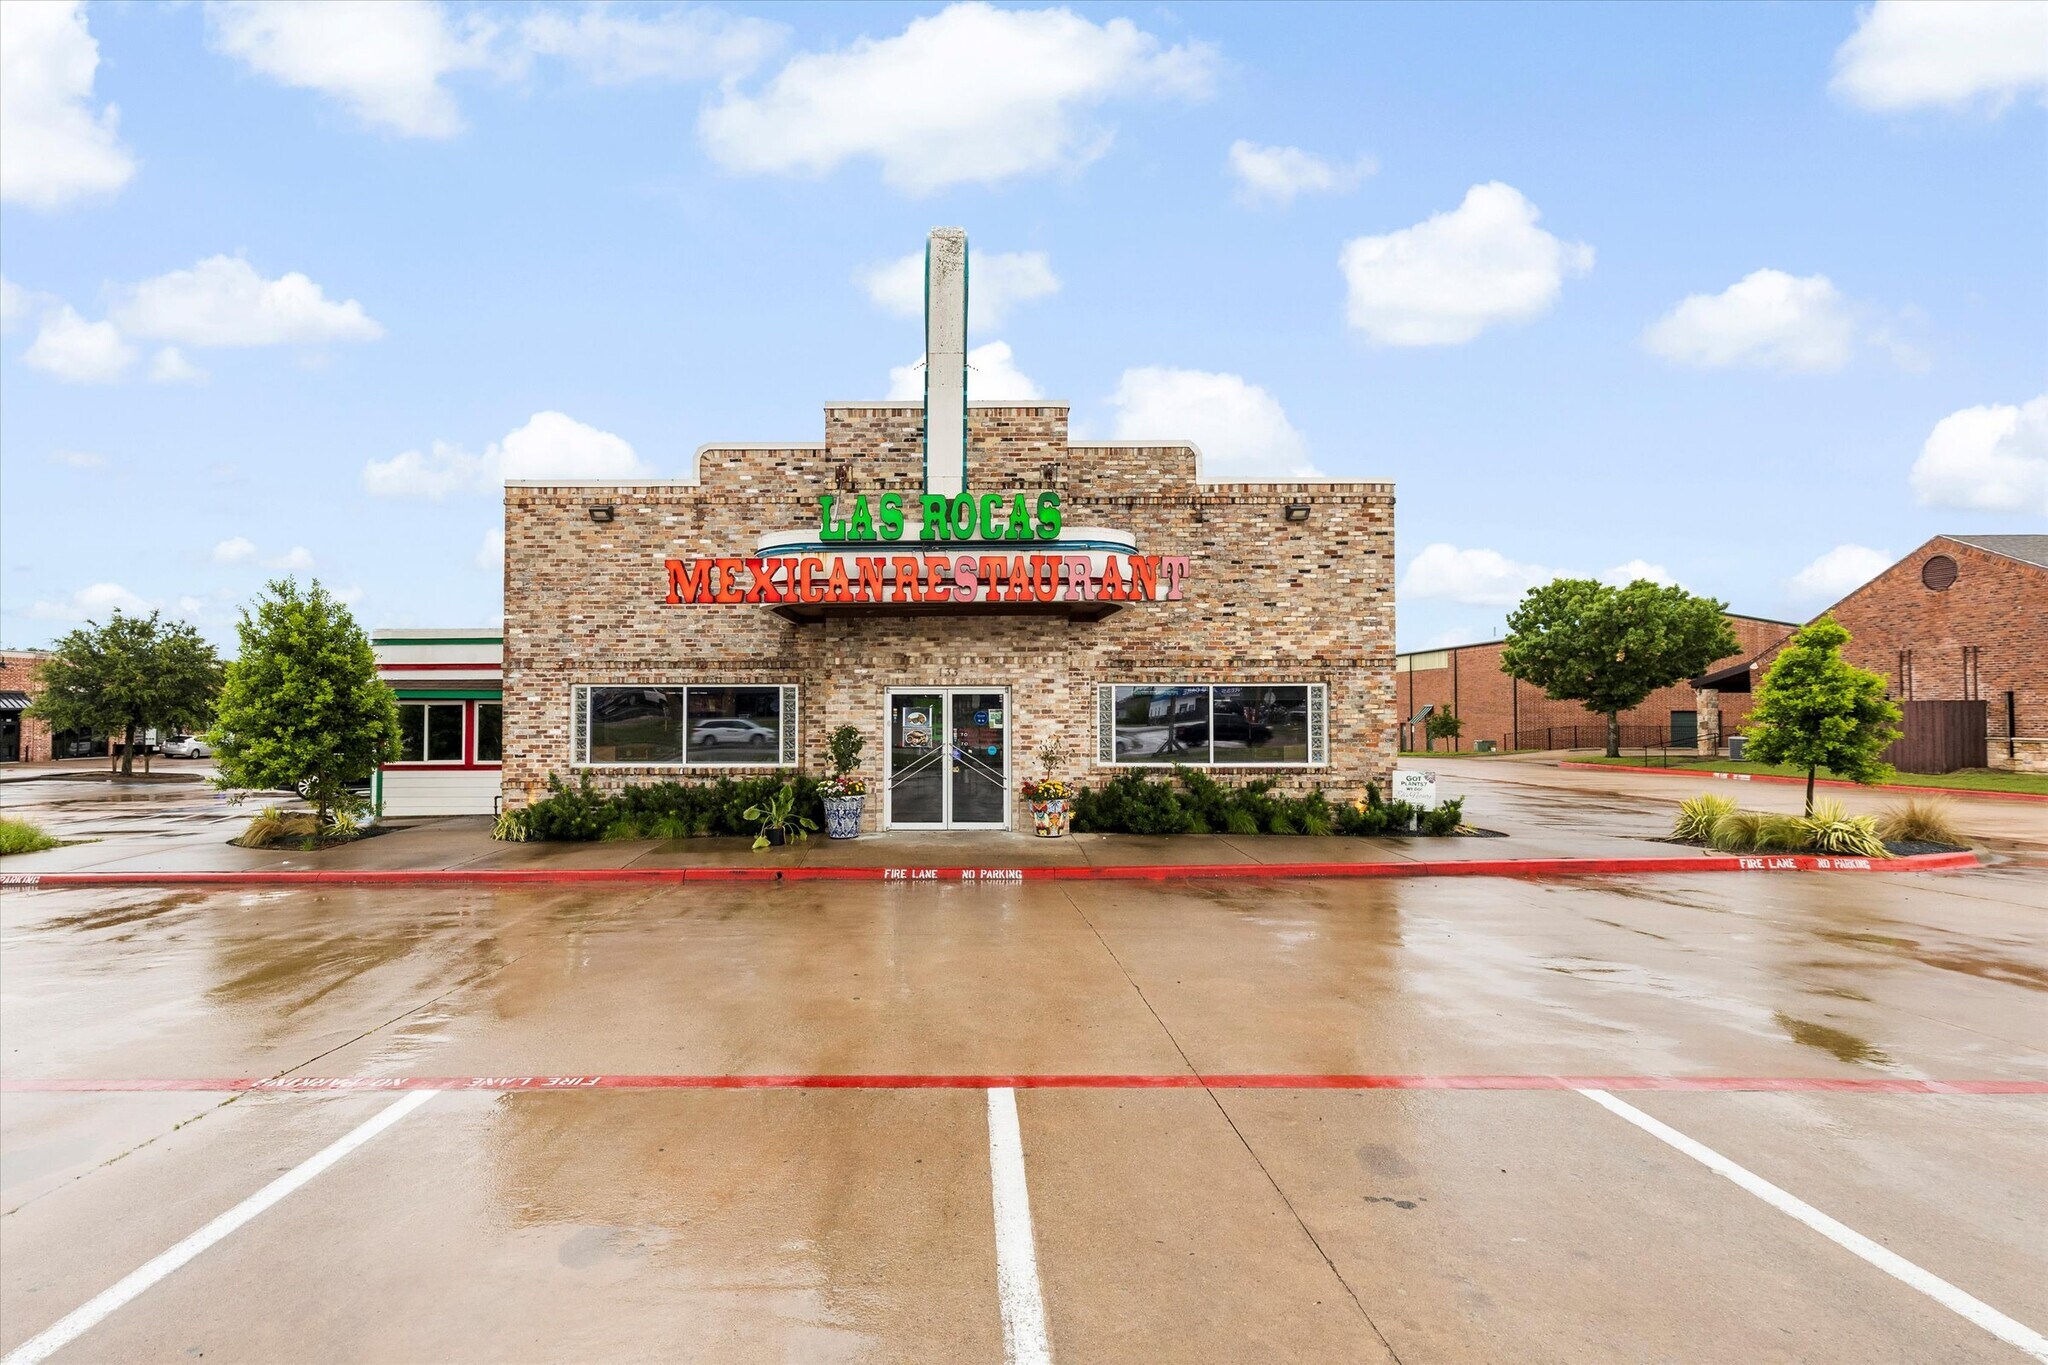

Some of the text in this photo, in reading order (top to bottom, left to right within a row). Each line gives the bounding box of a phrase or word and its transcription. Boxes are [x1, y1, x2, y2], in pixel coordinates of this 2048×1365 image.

[819, 491, 1062, 541] LAS ROCAS
[1739, 858, 1871, 869] FIRE LANE NO PARKING
[884, 869, 1023, 879] FIRE LANE NO PARKING
[541, 1077, 601, 1087] FIRE
